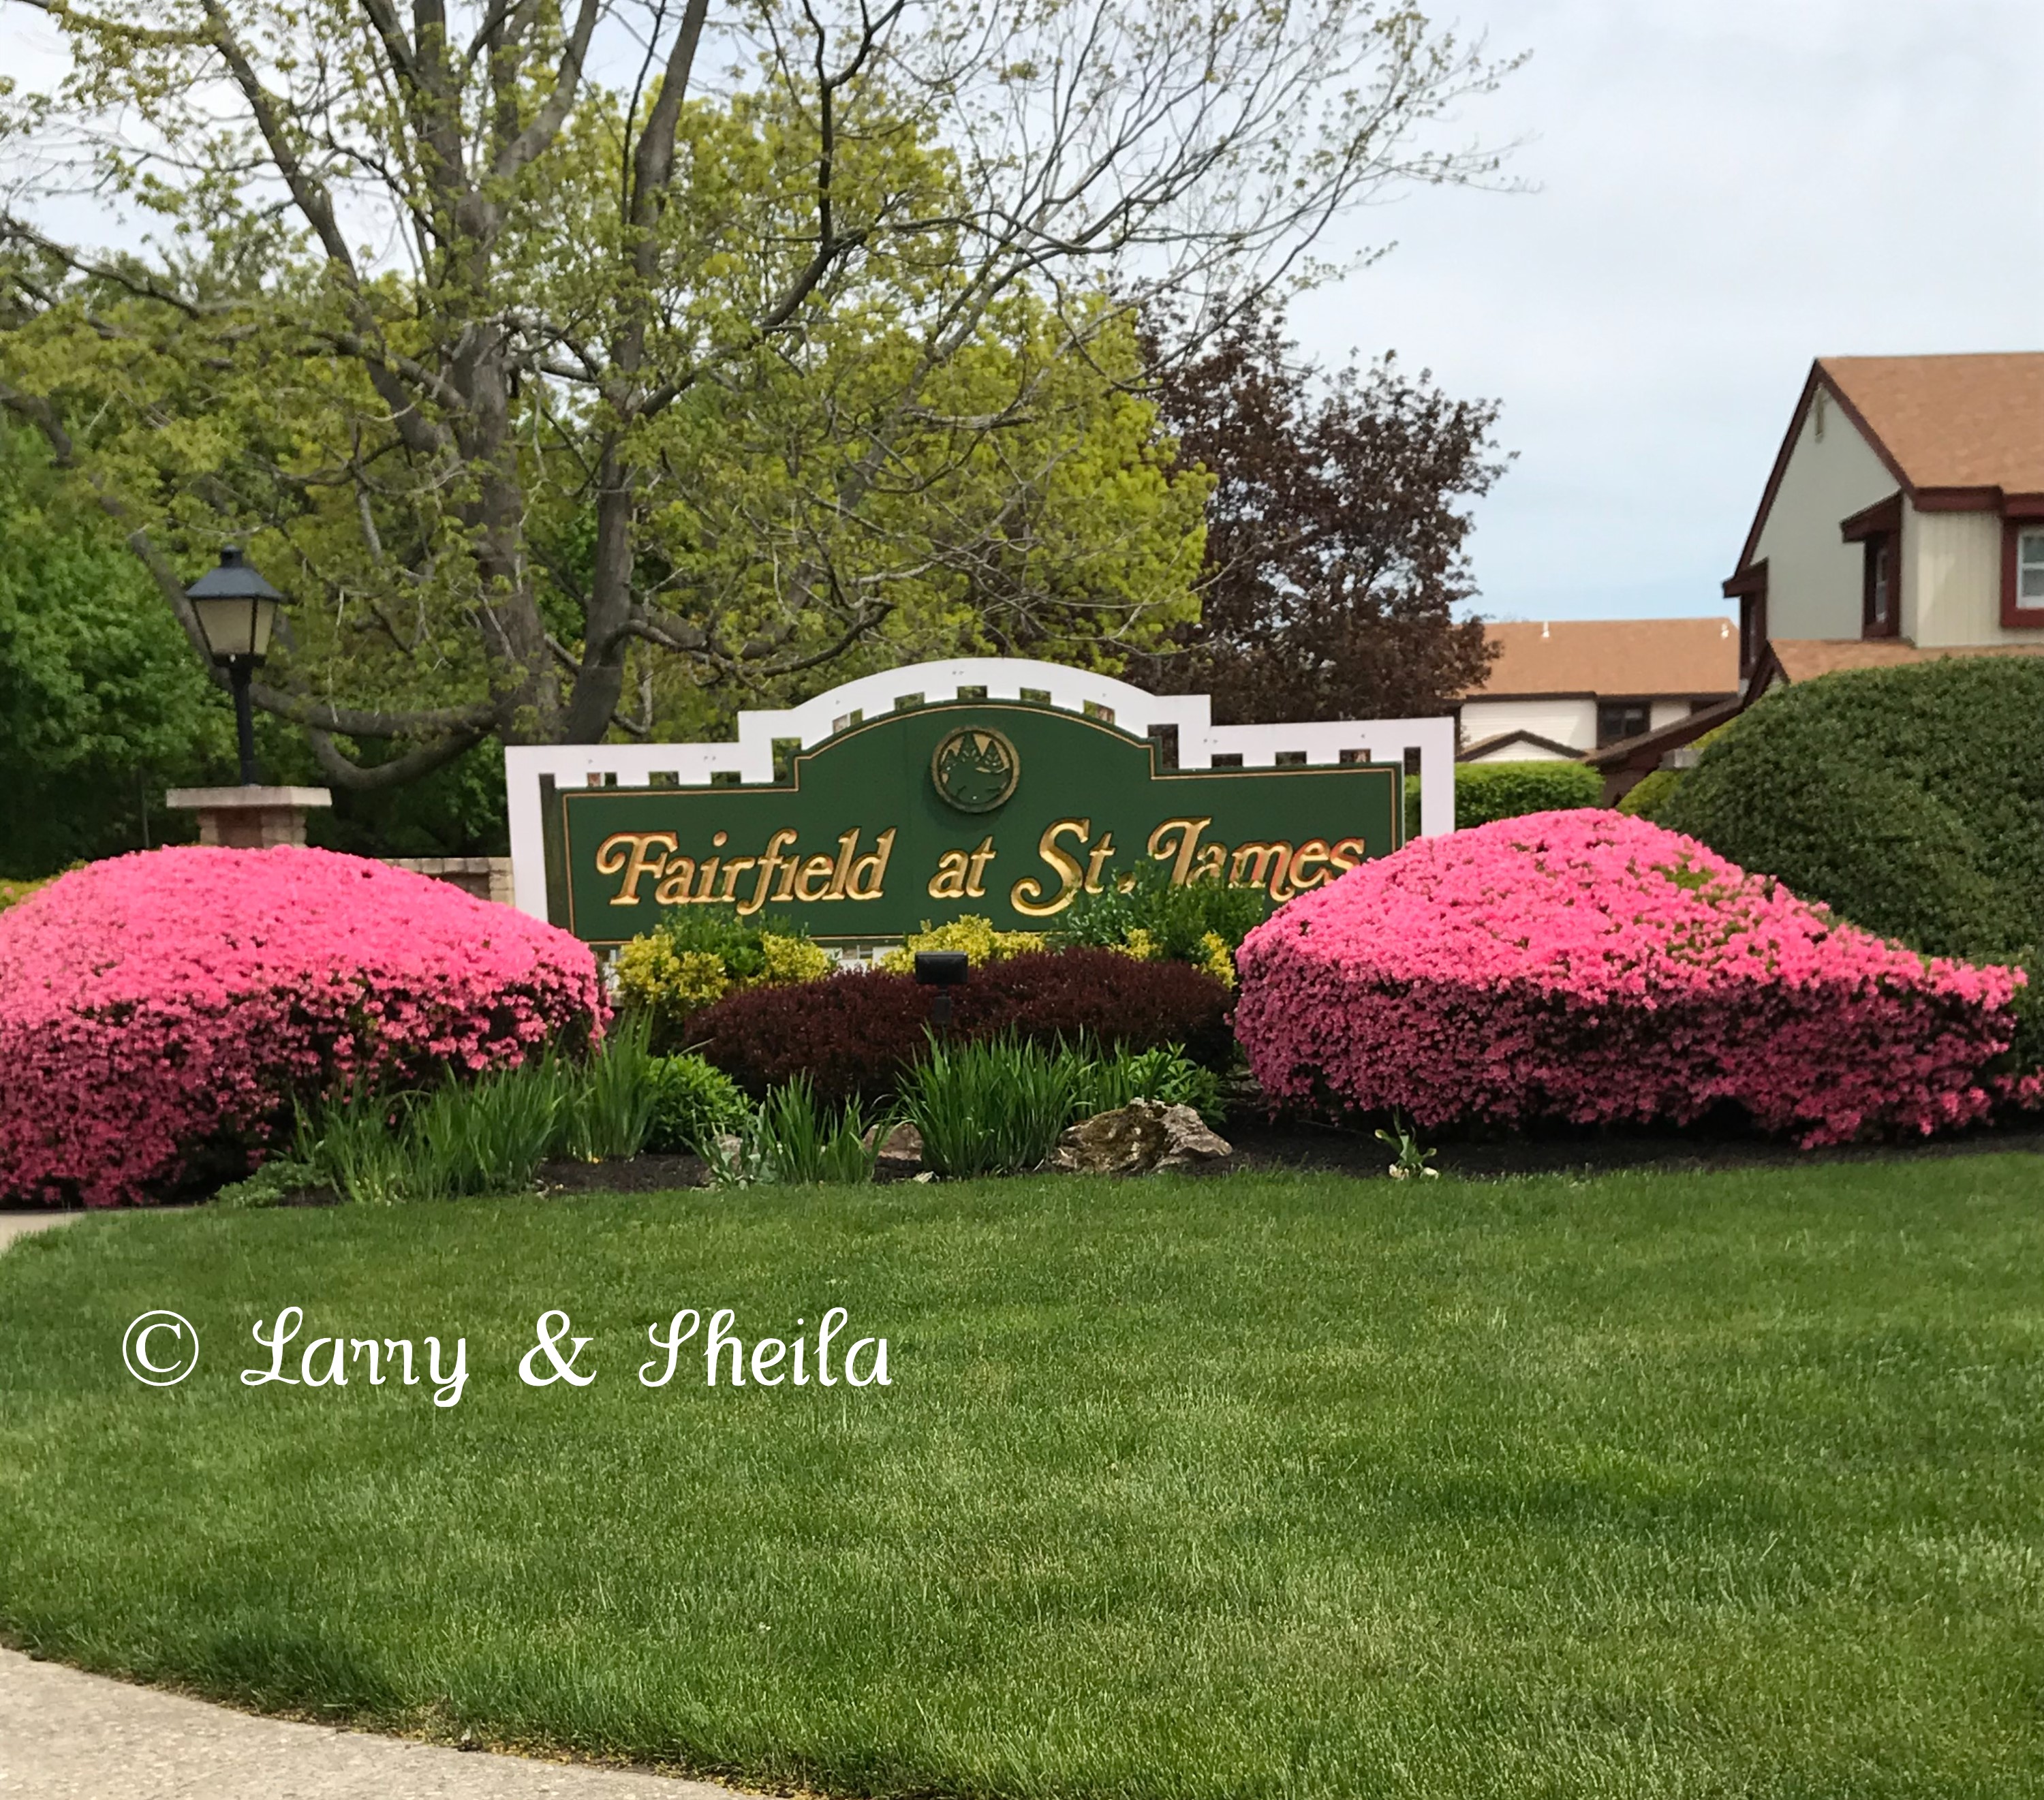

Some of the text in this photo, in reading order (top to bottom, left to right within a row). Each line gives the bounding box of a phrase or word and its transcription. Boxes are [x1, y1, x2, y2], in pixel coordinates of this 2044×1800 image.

[595, 826, 897, 915] Fairfield
[928, 835, 997, 899] at
[1147, 816, 1365, 902] James
